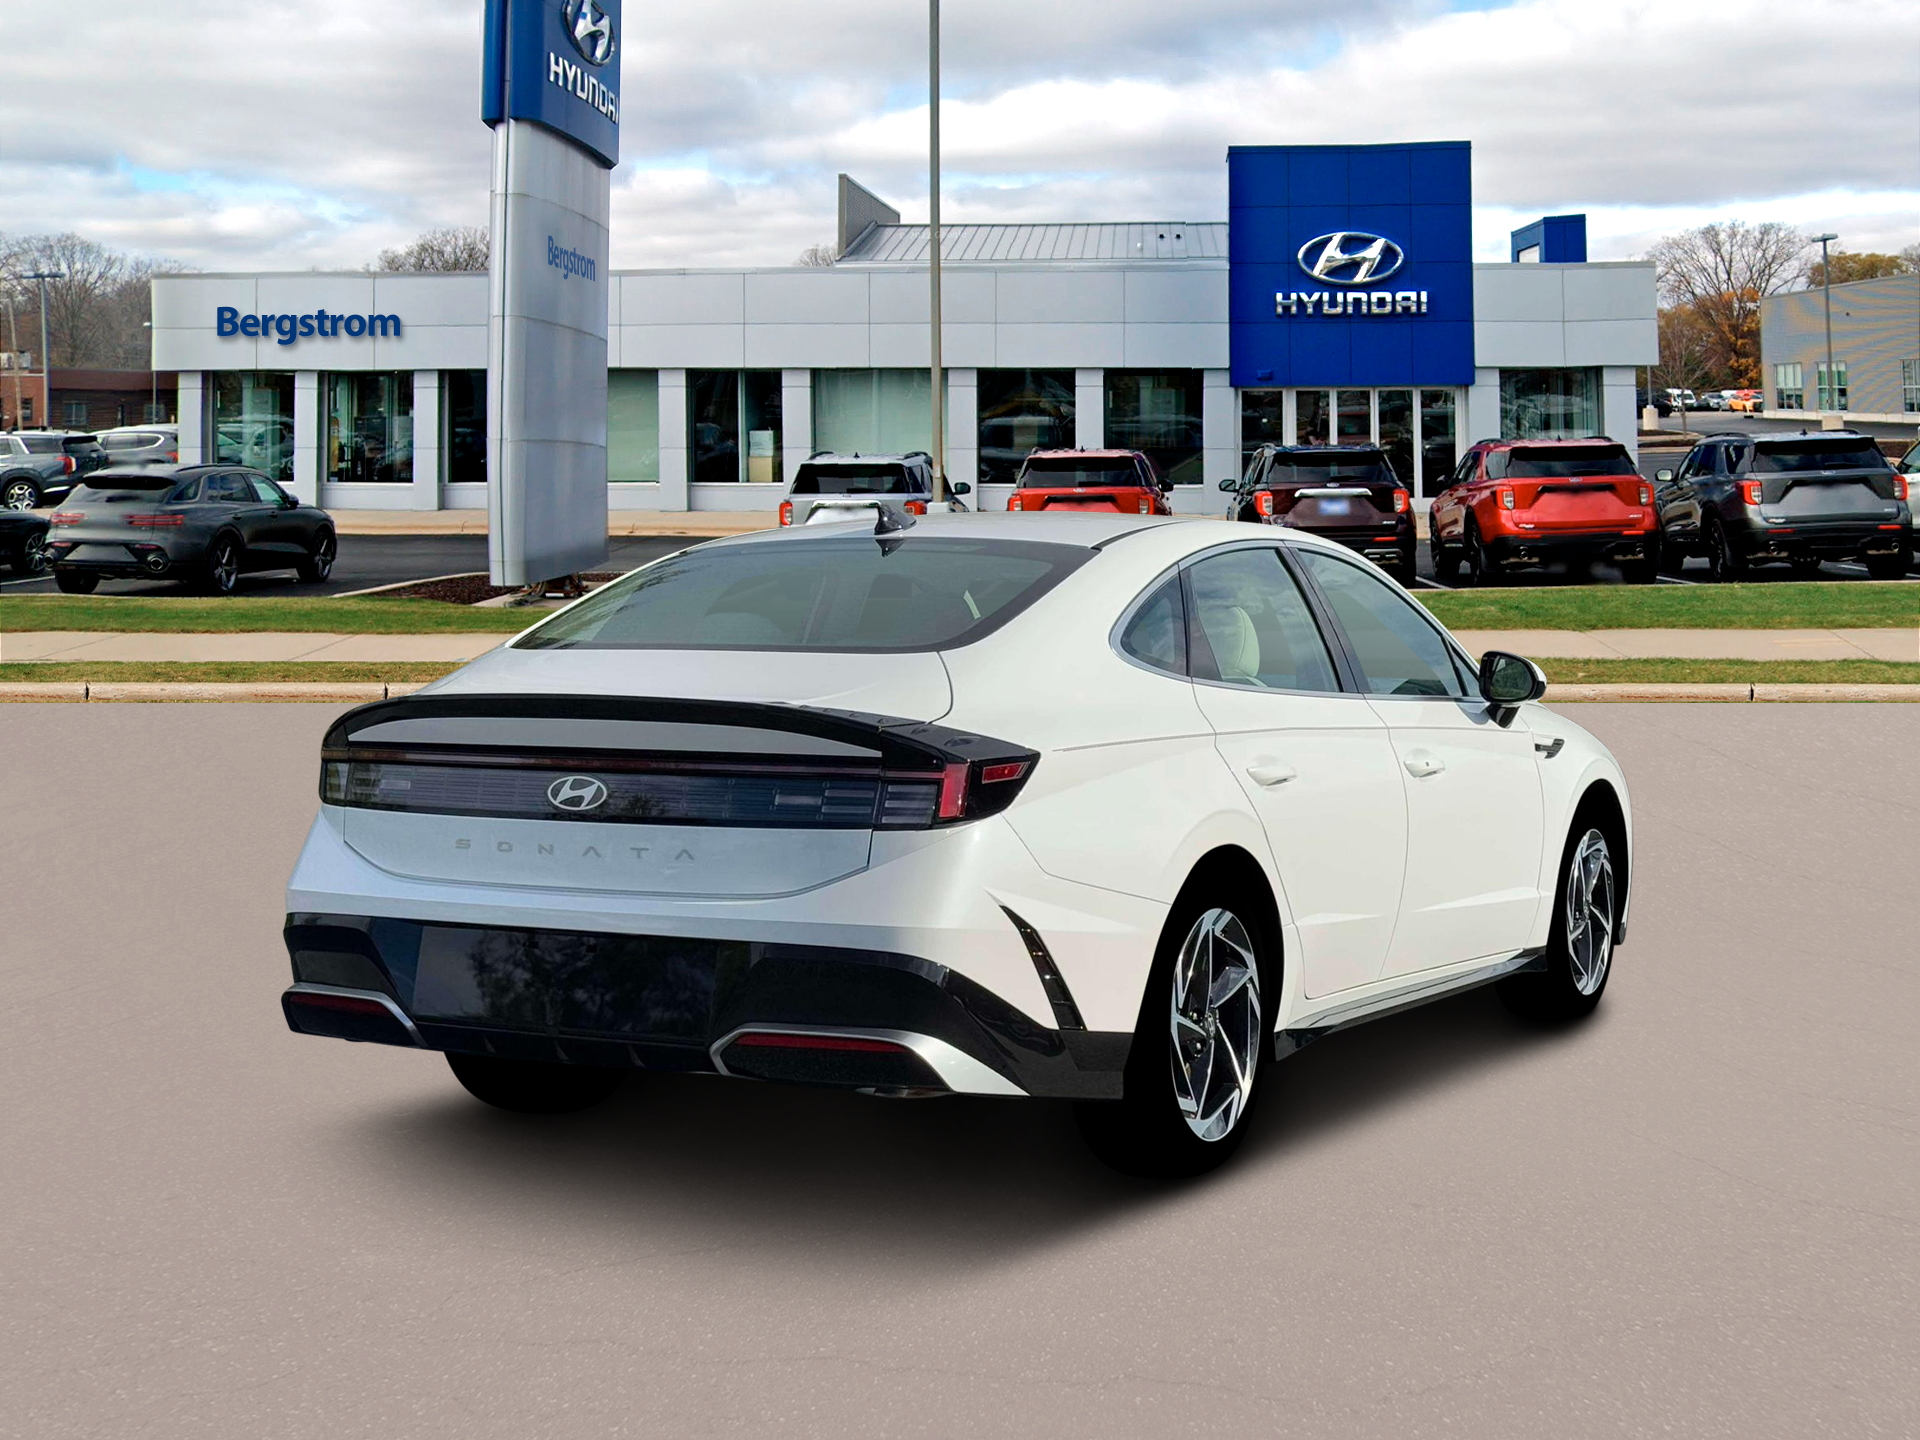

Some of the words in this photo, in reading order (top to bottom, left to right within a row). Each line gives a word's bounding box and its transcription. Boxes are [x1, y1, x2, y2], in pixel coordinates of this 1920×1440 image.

[549, 52, 619, 124] HYUNDAI
[547, 235, 596, 282] Bergstrom
[1275, 291, 1428, 315] HYUNDAI
[216, 306, 401, 346] Bergstrom
[454, 838, 695, 861] SONATA
